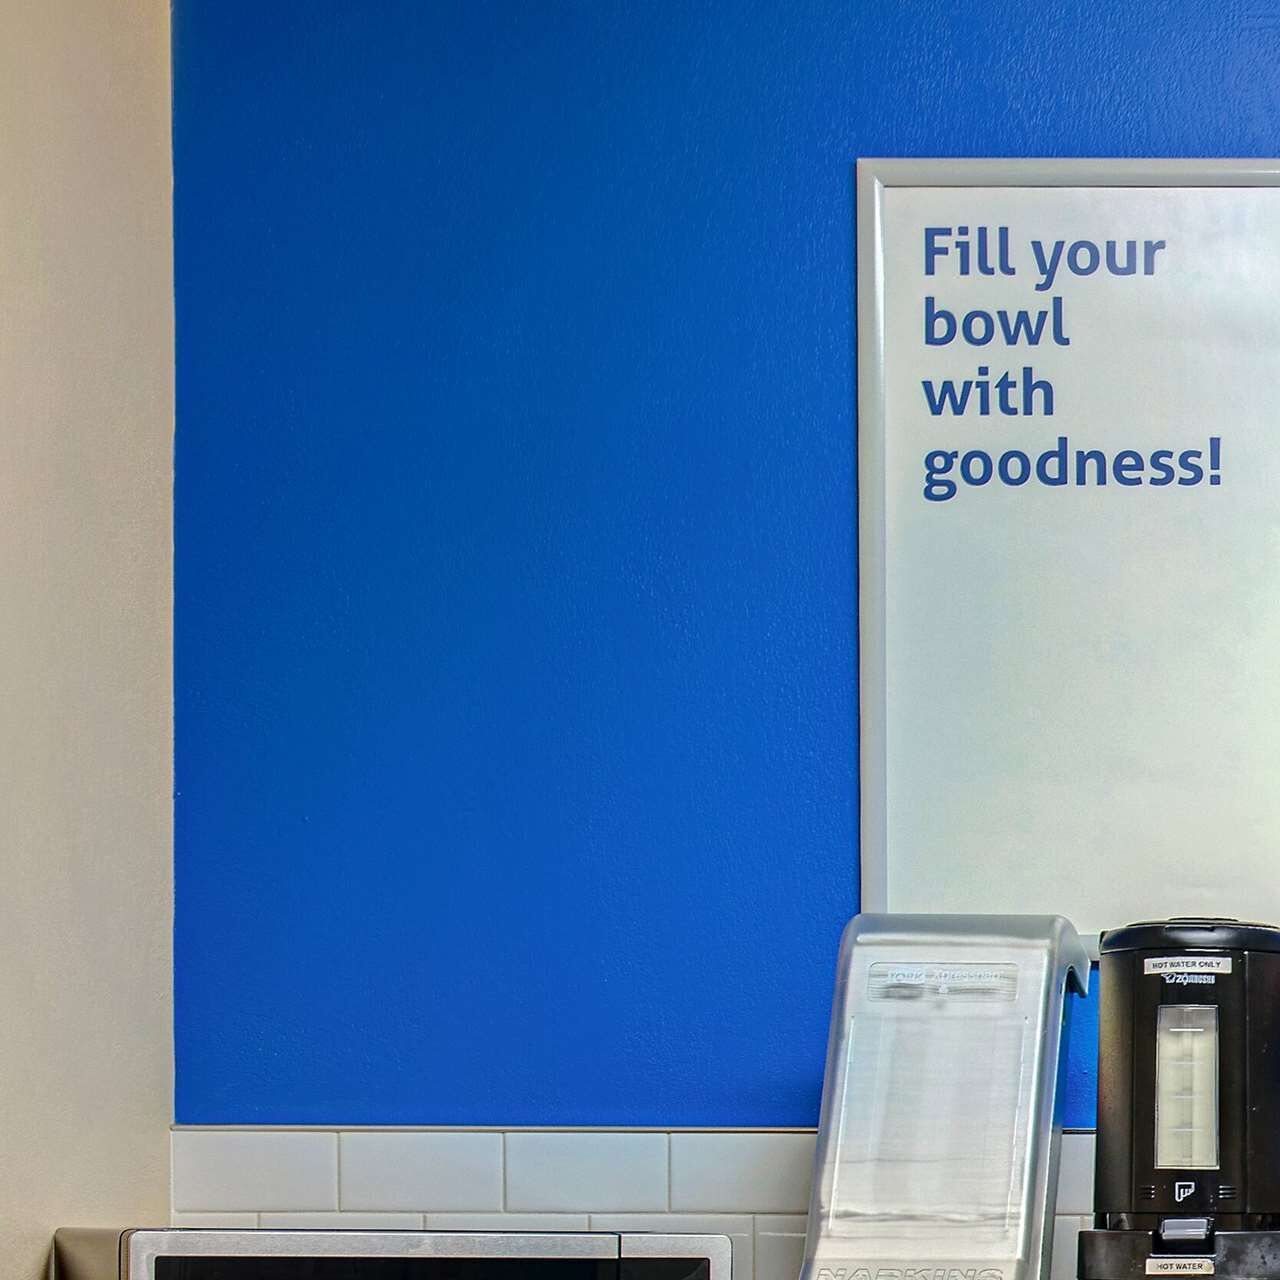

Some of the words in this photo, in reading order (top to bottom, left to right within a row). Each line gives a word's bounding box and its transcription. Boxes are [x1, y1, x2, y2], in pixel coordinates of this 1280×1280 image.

[924, 226, 1017, 276] Fill
[1030, 240, 1166, 292] your
[924, 296, 1071, 347] bowl
[922, 366, 1054, 416] with
[923, 437, 1221, 502] goodness!
[1152, 961, 1168, 969] HOT
[1169, 960, 1198, 969] WATER
[1199, 960, 1222, 969] ONLY
